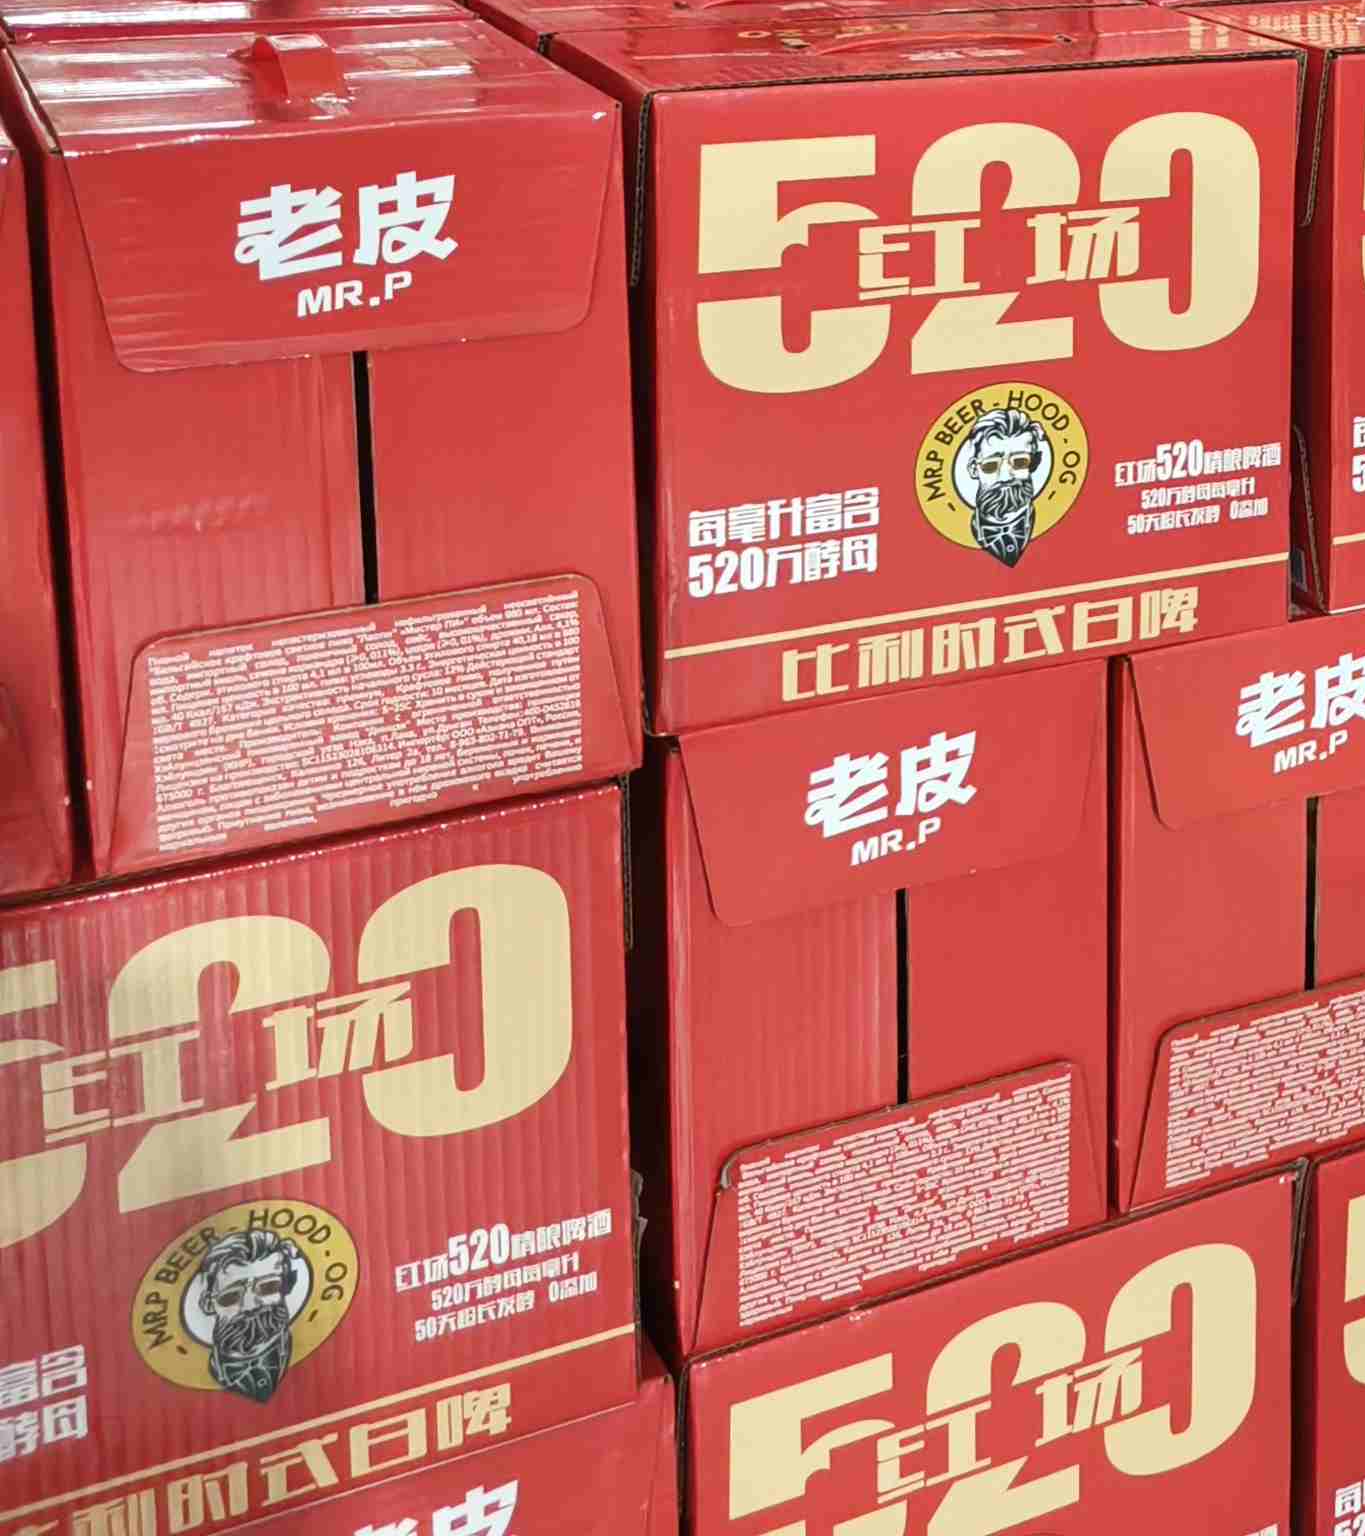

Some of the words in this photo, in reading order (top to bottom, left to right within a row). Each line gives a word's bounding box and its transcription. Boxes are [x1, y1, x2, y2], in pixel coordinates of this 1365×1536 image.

[233, 170, 459, 281] 老皮
[697, 111, 1260, 393] 520
[858, 206, 1140, 300] 红场
[297, 271, 413, 317] MR.P
[924, 450, 945, 501] MR.P
[935, 399, 986, 445] BEER
[1008, 390, 1069, 430] HOOD
[1059, 451, 1080, 485] OG
[688, 486, 880, 548] 每毫升富含
[688, 534, 877, 598] 520万酵母
[782, 586, 1198, 701] 比利时式白啤
[804, 730, 977, 840] 老皮
[1273, 730, 1348, 773] MR.P
[851, 817, 941, 866] MR.P
[40, 980, 415, 1144] 红场
[158, 1225, 216, 1286] BEER
[248, 1207, 333, 1244] HOOD
[319, 1261, 349, 1302] OG
[729, 1243, 1258, 1536] 520
[876, 1348, 1144, 1504] 红场
[4, 1383, 511, 1536] 利时式白啤
